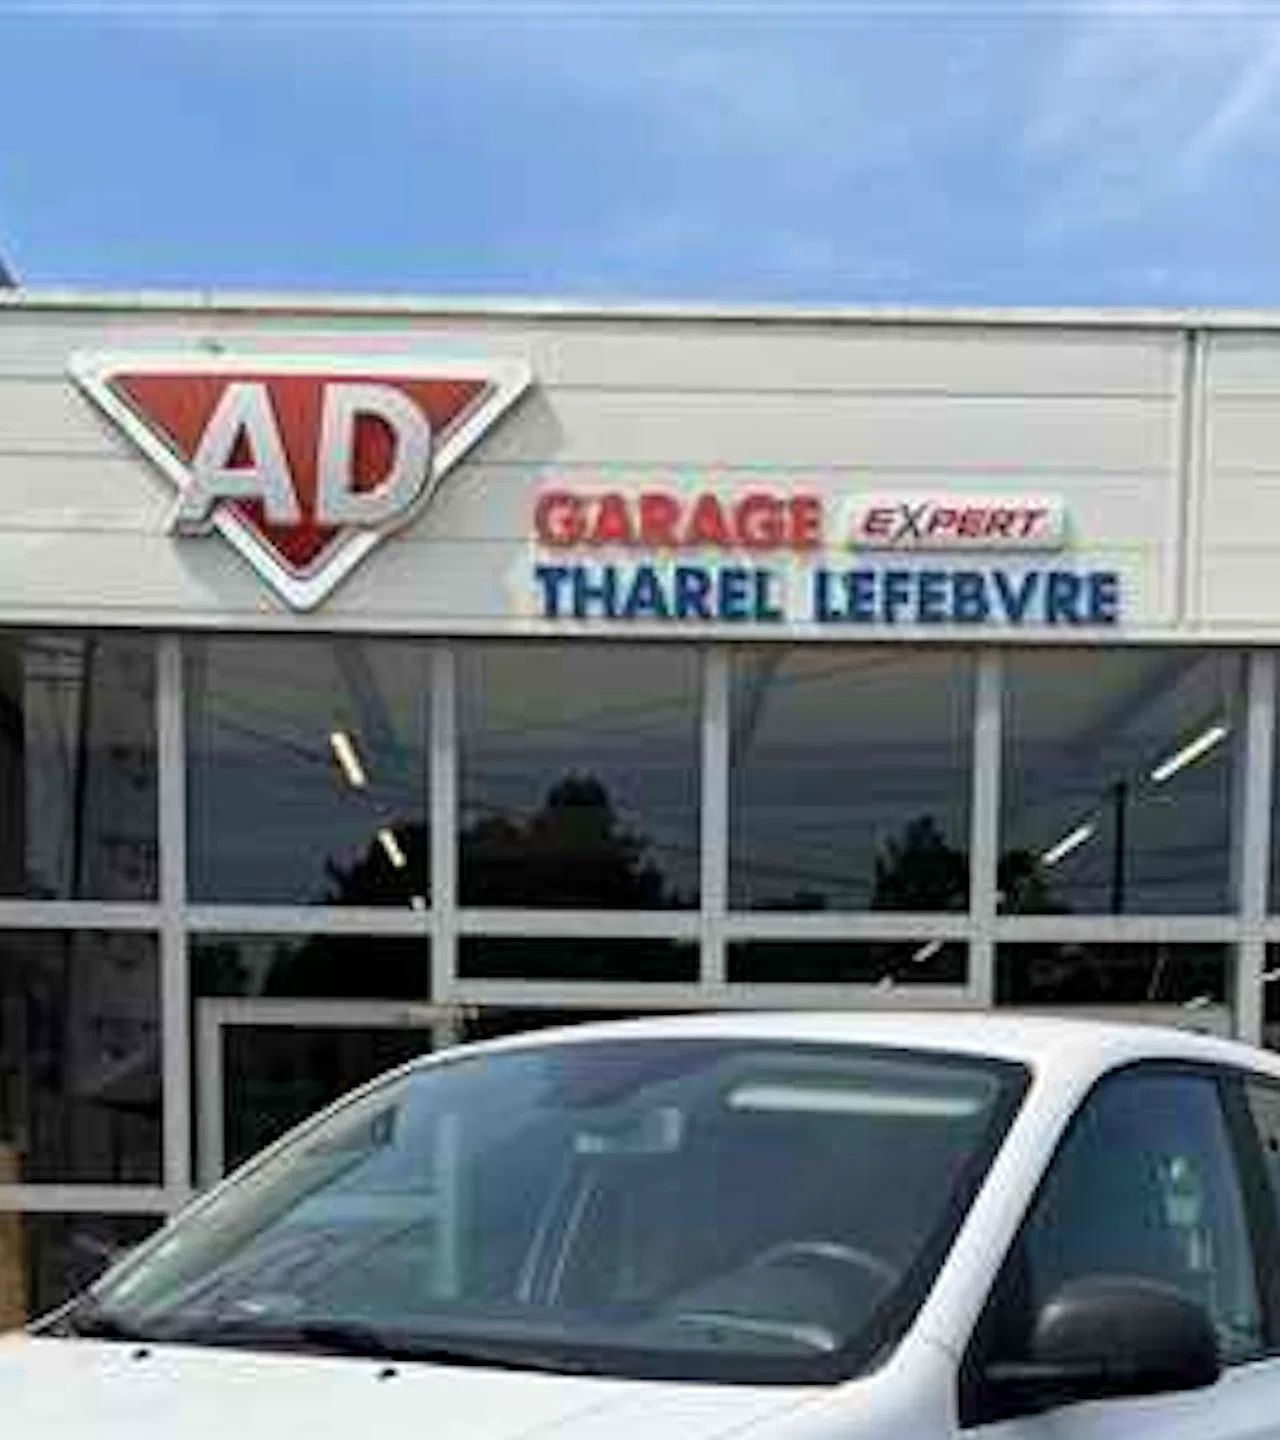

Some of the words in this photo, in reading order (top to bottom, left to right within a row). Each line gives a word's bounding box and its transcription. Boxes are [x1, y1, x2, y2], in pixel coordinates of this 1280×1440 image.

[169, 382, 434, 536] AD
[534, 493, 822, 548] GARAGE
[860, 503, 1048, 544] EXPERT
[534, 565, 786, 624] THAREL
[814, 565, 1121, 626] LEFEBVRE
